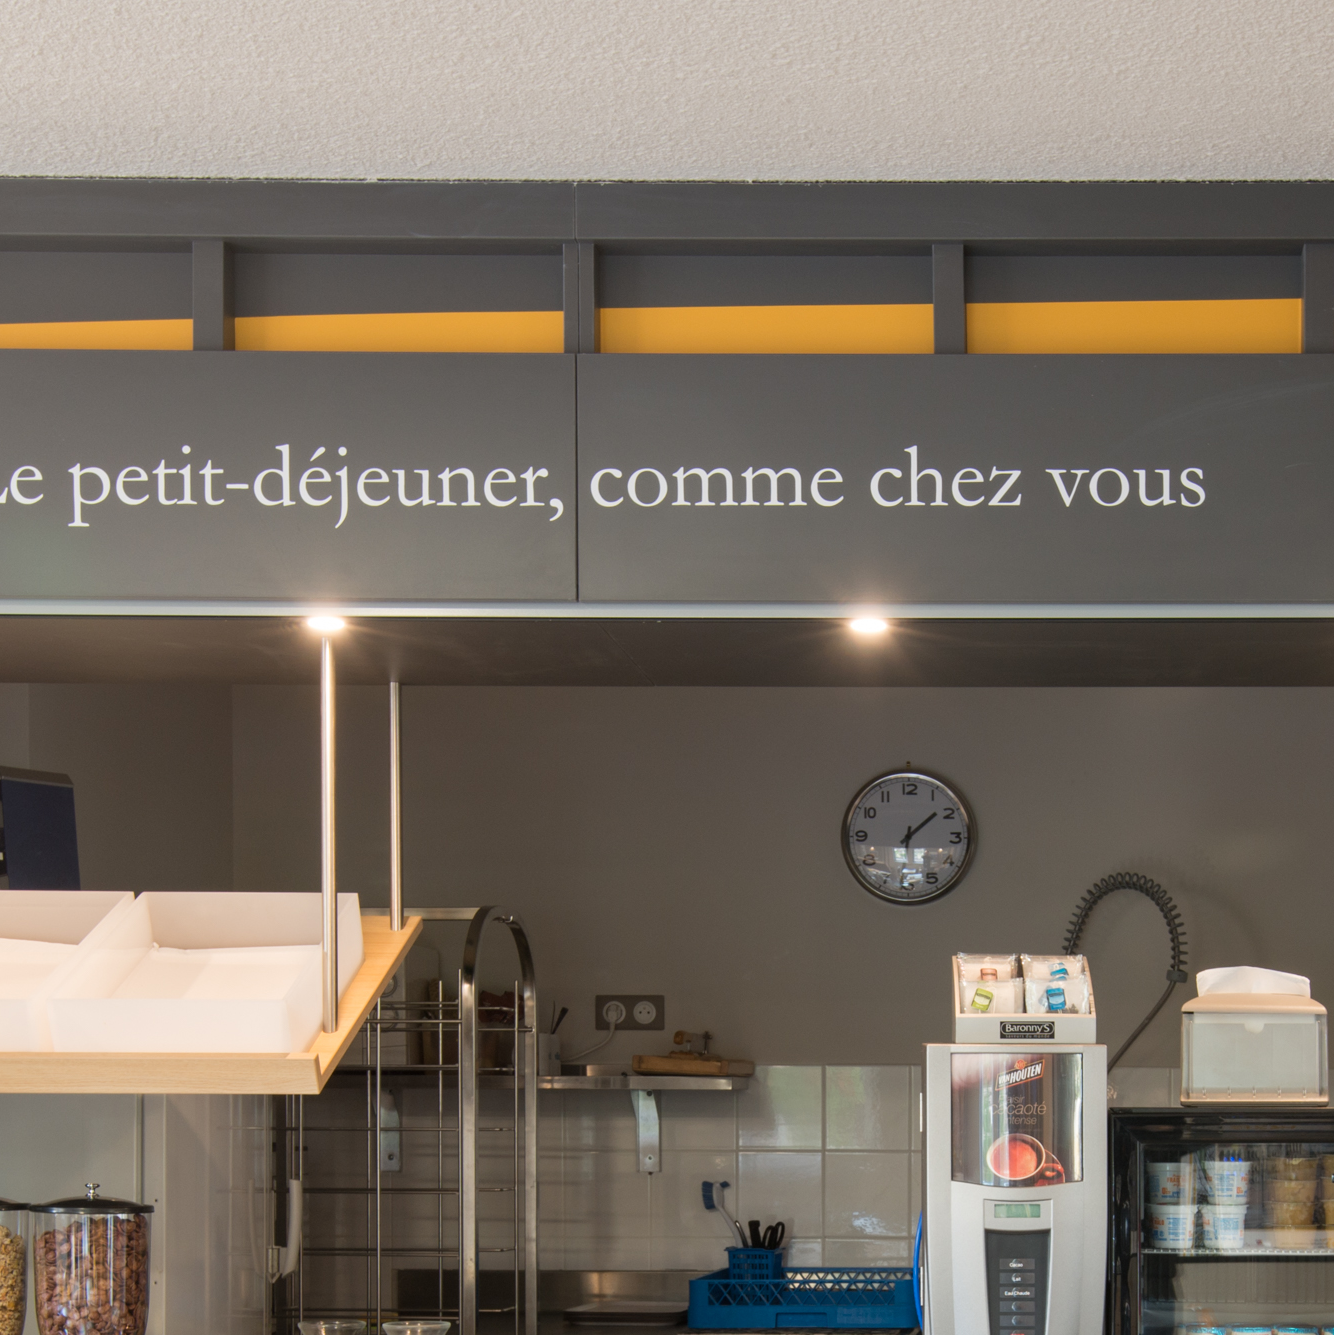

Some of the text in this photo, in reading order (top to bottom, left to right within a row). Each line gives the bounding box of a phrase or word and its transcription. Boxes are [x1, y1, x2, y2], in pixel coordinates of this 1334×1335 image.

[67, 443, 563, 528] petit-déjeuner,
[590, 466, 843, 507] comme
[870, 445, 1021, 506] chez
[1045, 467, 1205, 507] vous
[902, 783, 918, 795] 12
[881, 791, 890, 803] 11
[864, 807, 877, 819] 10
[943, 807, 955, 820] 2
[855, 830, 868, 842] 9
[949, 831, 962, 844] 3
[862, 853, 876, 866] 8
[942, 854, 955, 866] 4
[925, 872, 938, 885] 5
[1009, 1063, 1043, 1084] HOUTEN
[1005, 1116, 1037, 1125] ntense
